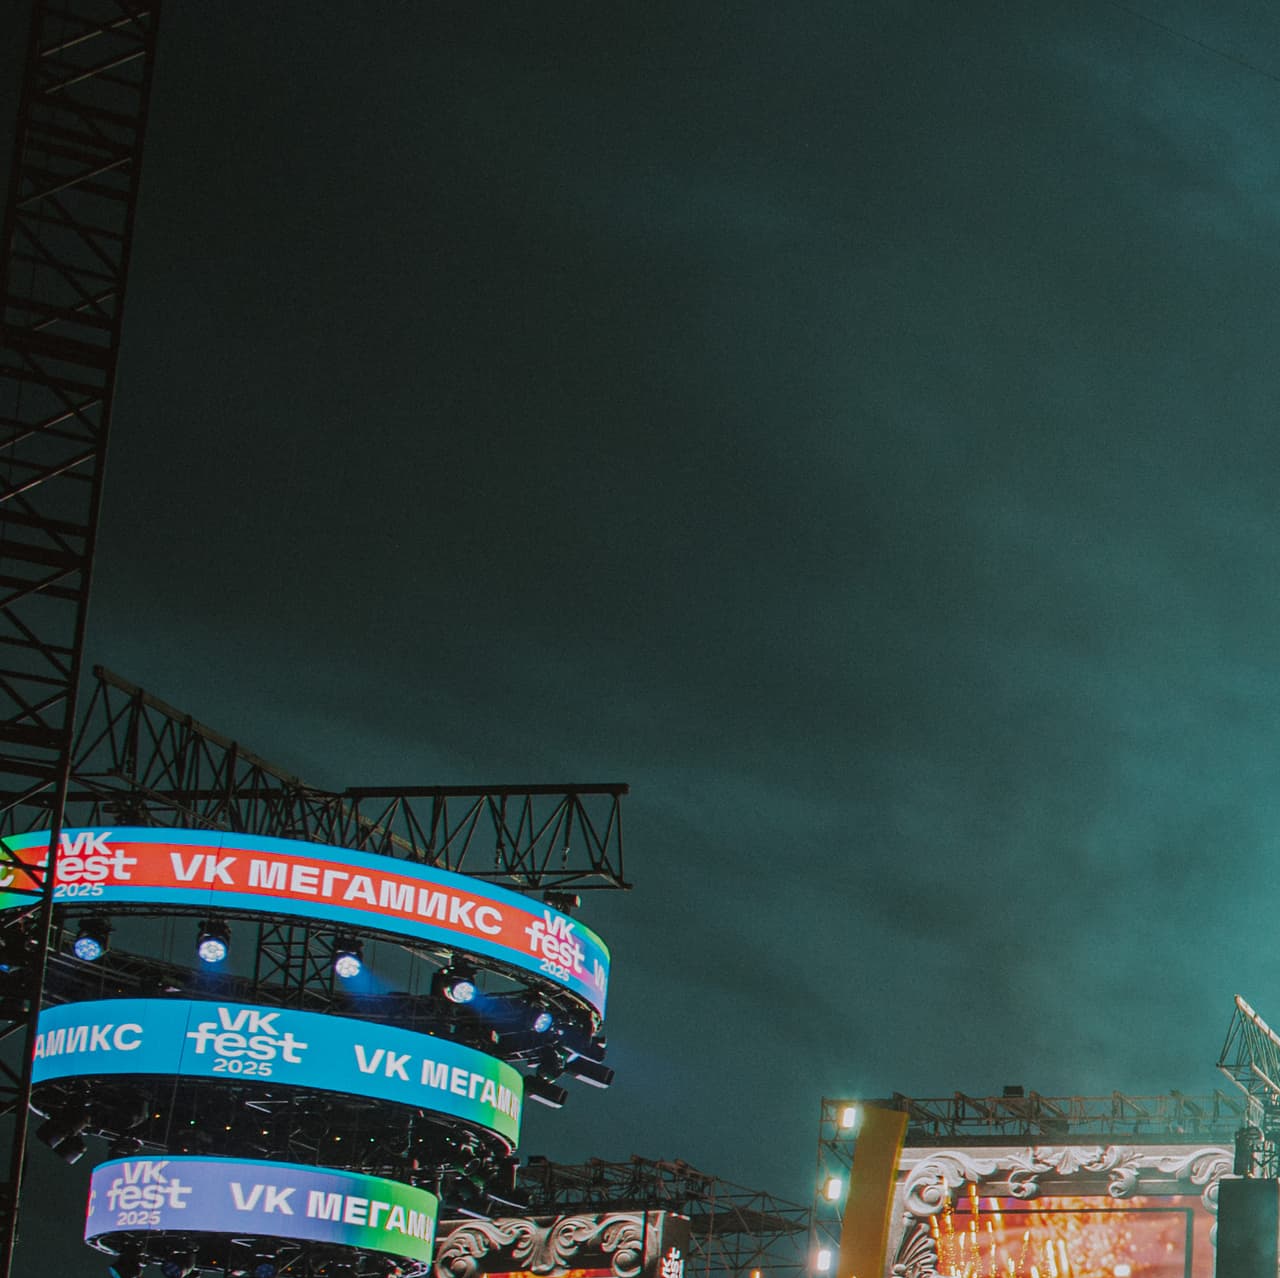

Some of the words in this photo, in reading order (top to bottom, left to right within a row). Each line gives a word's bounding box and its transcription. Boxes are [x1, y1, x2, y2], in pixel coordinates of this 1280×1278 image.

[61, 832, 112, 856] VK
[54, 882, 105, 897] 2025
[170, 853, 238, 885] VK
[248, 859, 503, 935] МЕГАМИКС
[544, 910, 576, 944] VK
[525, 920, 585, 974] fest
[539, 958, 570, 982] 2025
[218, 1007, 280, 1035] VK
[186, 1022, 308, 1064] fest
[212, 1058, 272, 1077] 2025
[354, 1044, 411, 1081] VK
[122, 1161, 170, 1184] VK
[107, 1178, 193, 1212] fest
[229, 1182, 297, 1215] VK
[116, 1211, 161, 1226] 2025
